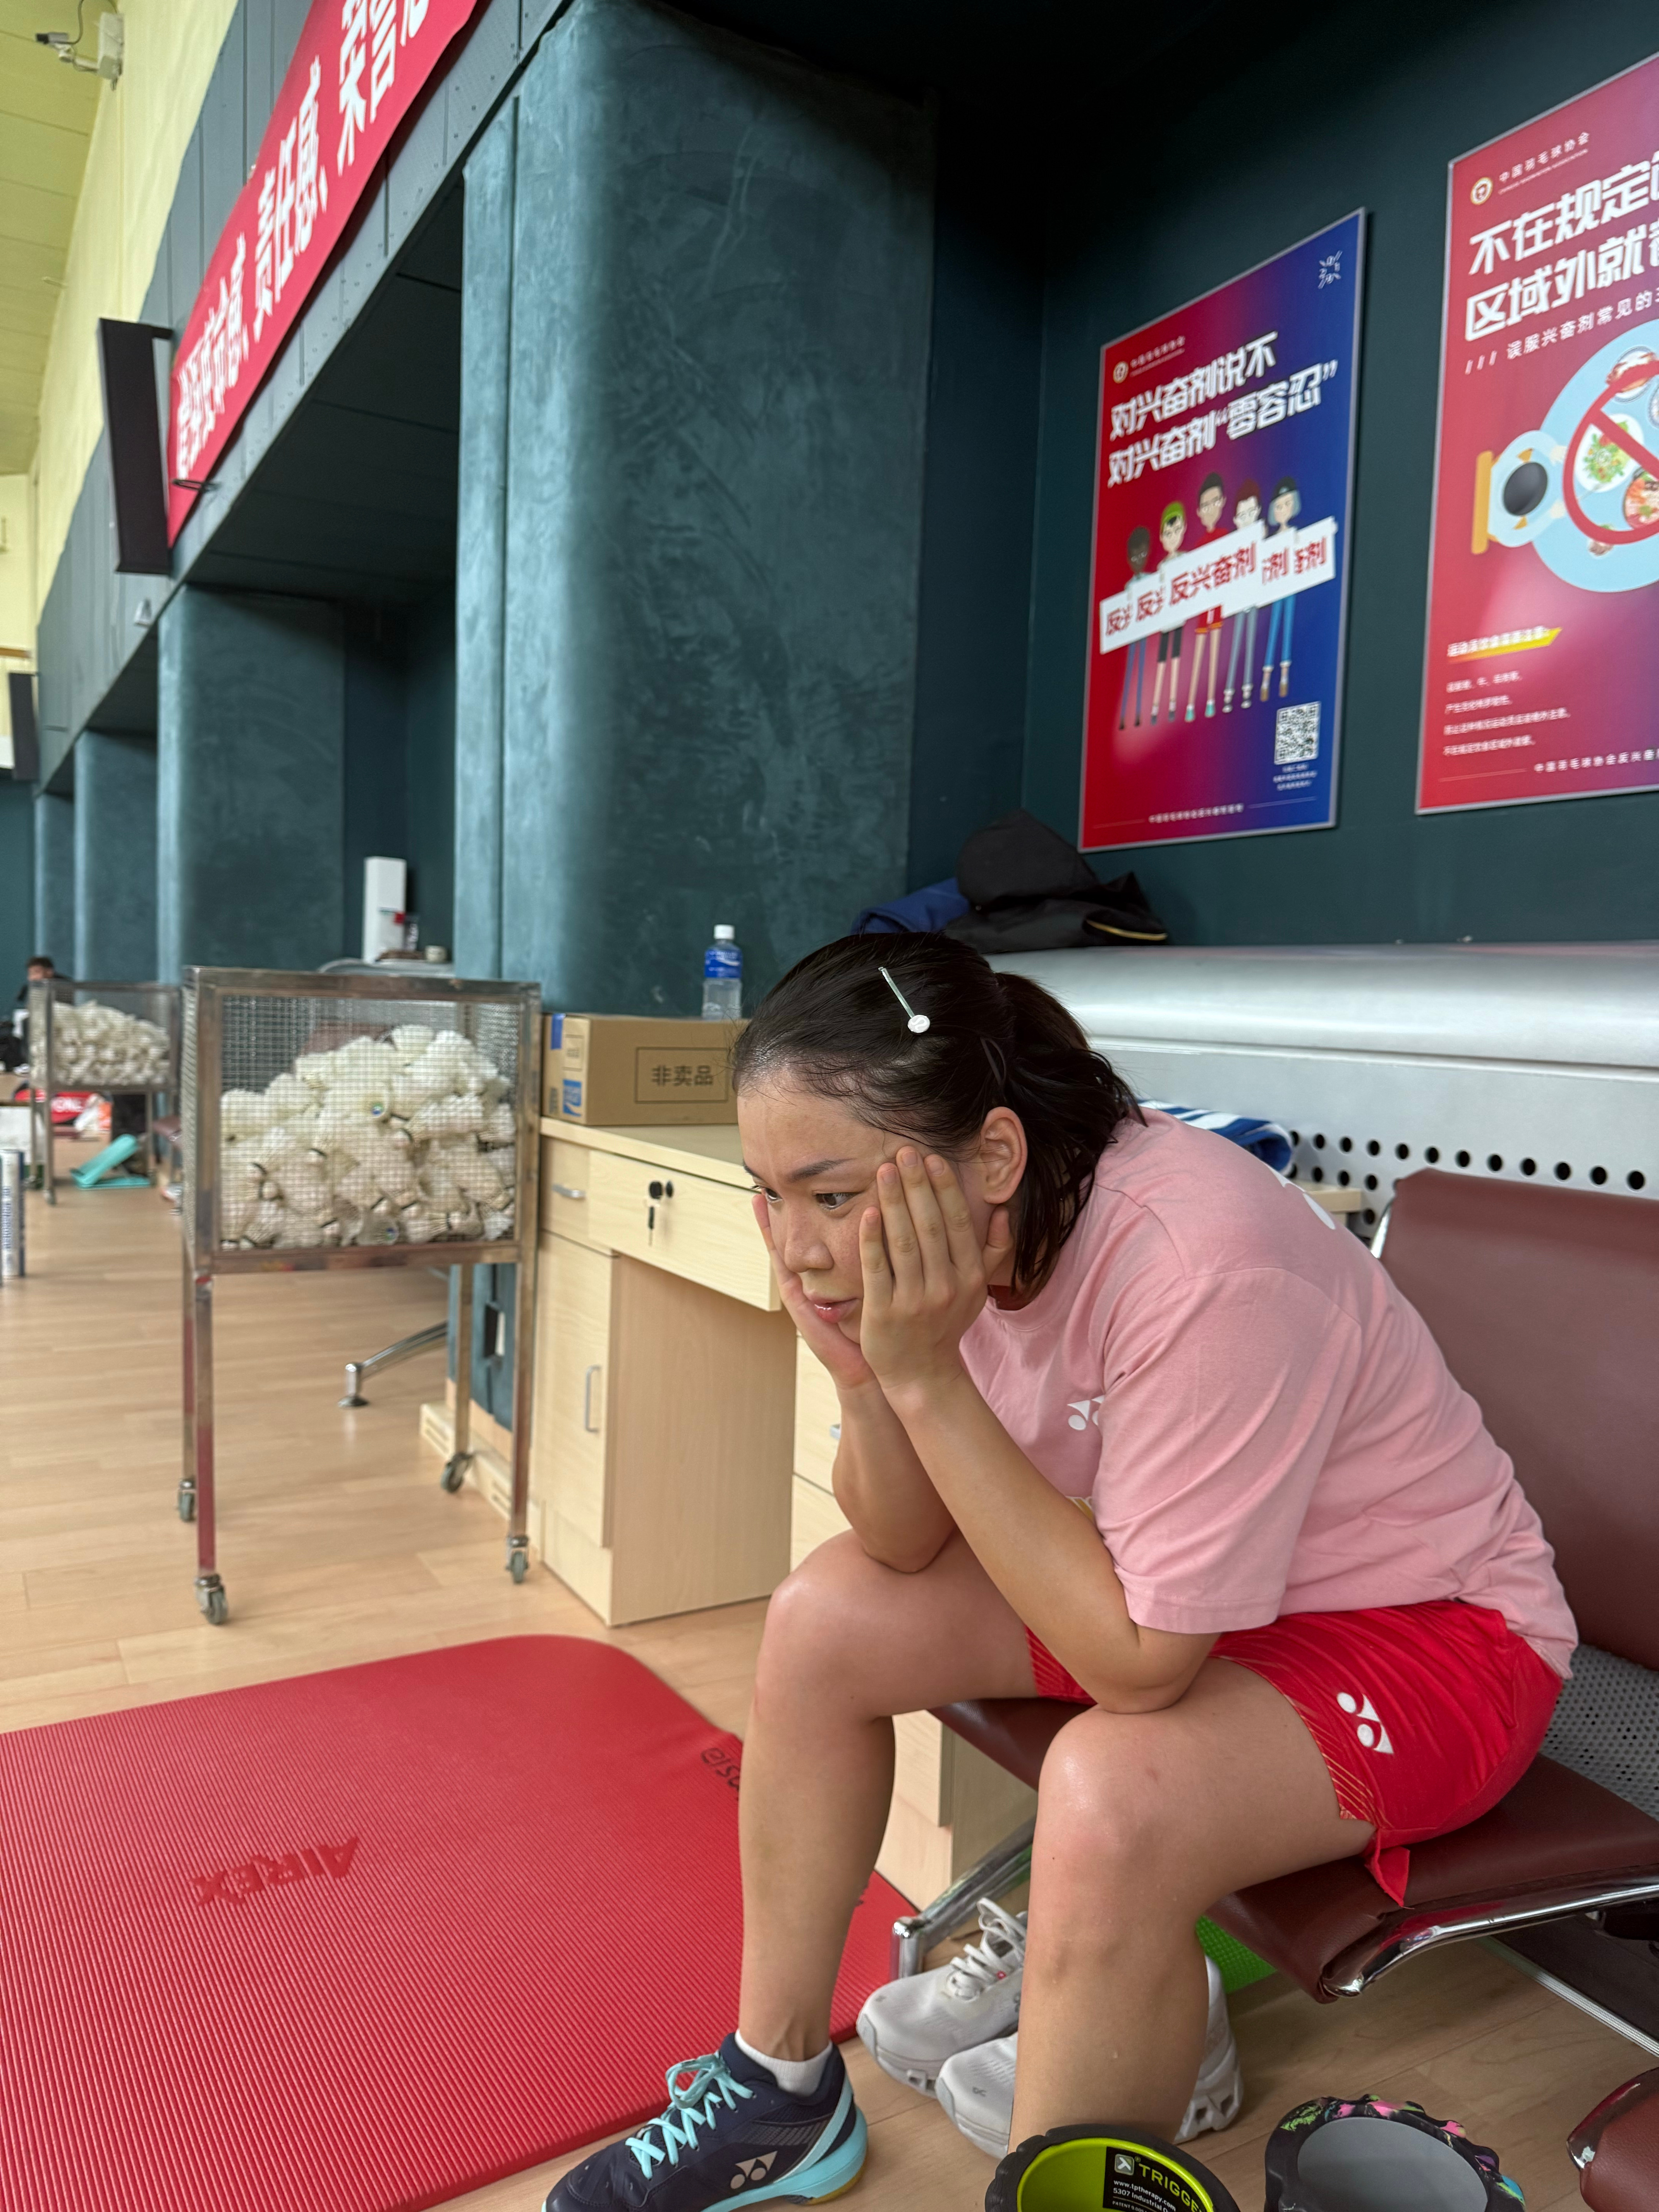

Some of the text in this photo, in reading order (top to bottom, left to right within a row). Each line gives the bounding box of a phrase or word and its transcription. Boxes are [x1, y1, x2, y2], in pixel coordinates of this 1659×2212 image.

[1506, 286, 1659, 359] 误服兴奋剂常见的
[1110, 331, 1278, 441] 对兴奋剂说不
[1169, 541, 1257, 606] 反兴奋剂
[651, 1064, 713, 1087] 非卖品
[191, 1836, 360, 1906] AIREX
[1113, 2179, 1176, 2212] www.tptherapy.com
[1113, 2188, 1130, 2196] 5307
[1132, 2191, 1162, 2211] Industrial
[1139, 2163, 1202, 2212] TRIGGE
